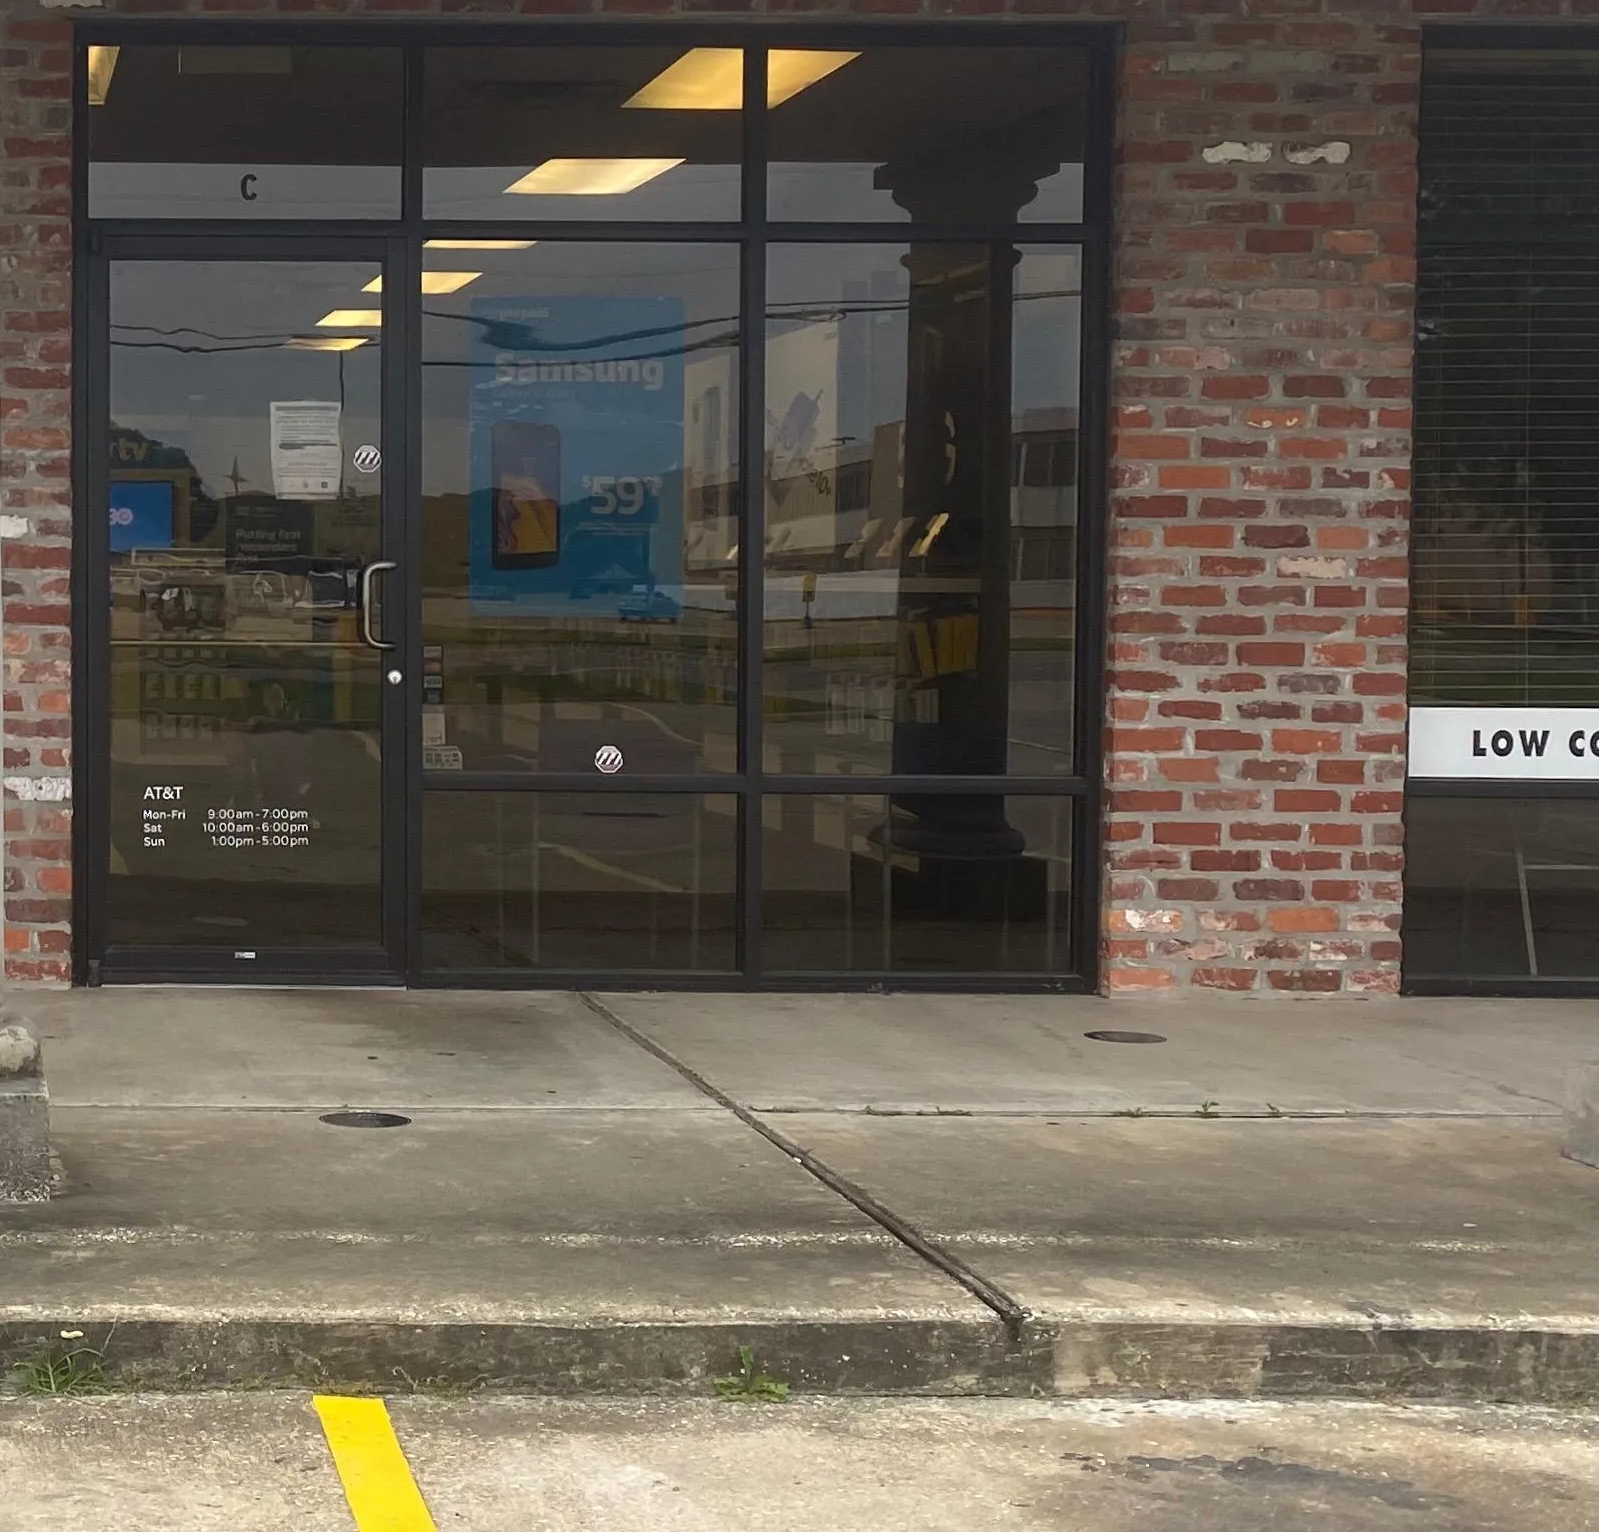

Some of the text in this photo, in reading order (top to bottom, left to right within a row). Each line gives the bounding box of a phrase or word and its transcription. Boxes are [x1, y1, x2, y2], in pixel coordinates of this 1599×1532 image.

[240, 174, 258, 201] C
[495, 352, 664, 392] Samsung
[1472, 729, 1551, 758] LOW
[143, 786, 184, 800] AT&T
[142, 808, 186, 820] Mon-Fri
[143, 822, 163, 834] Sat
[143, 836, 166, 847] Sun
